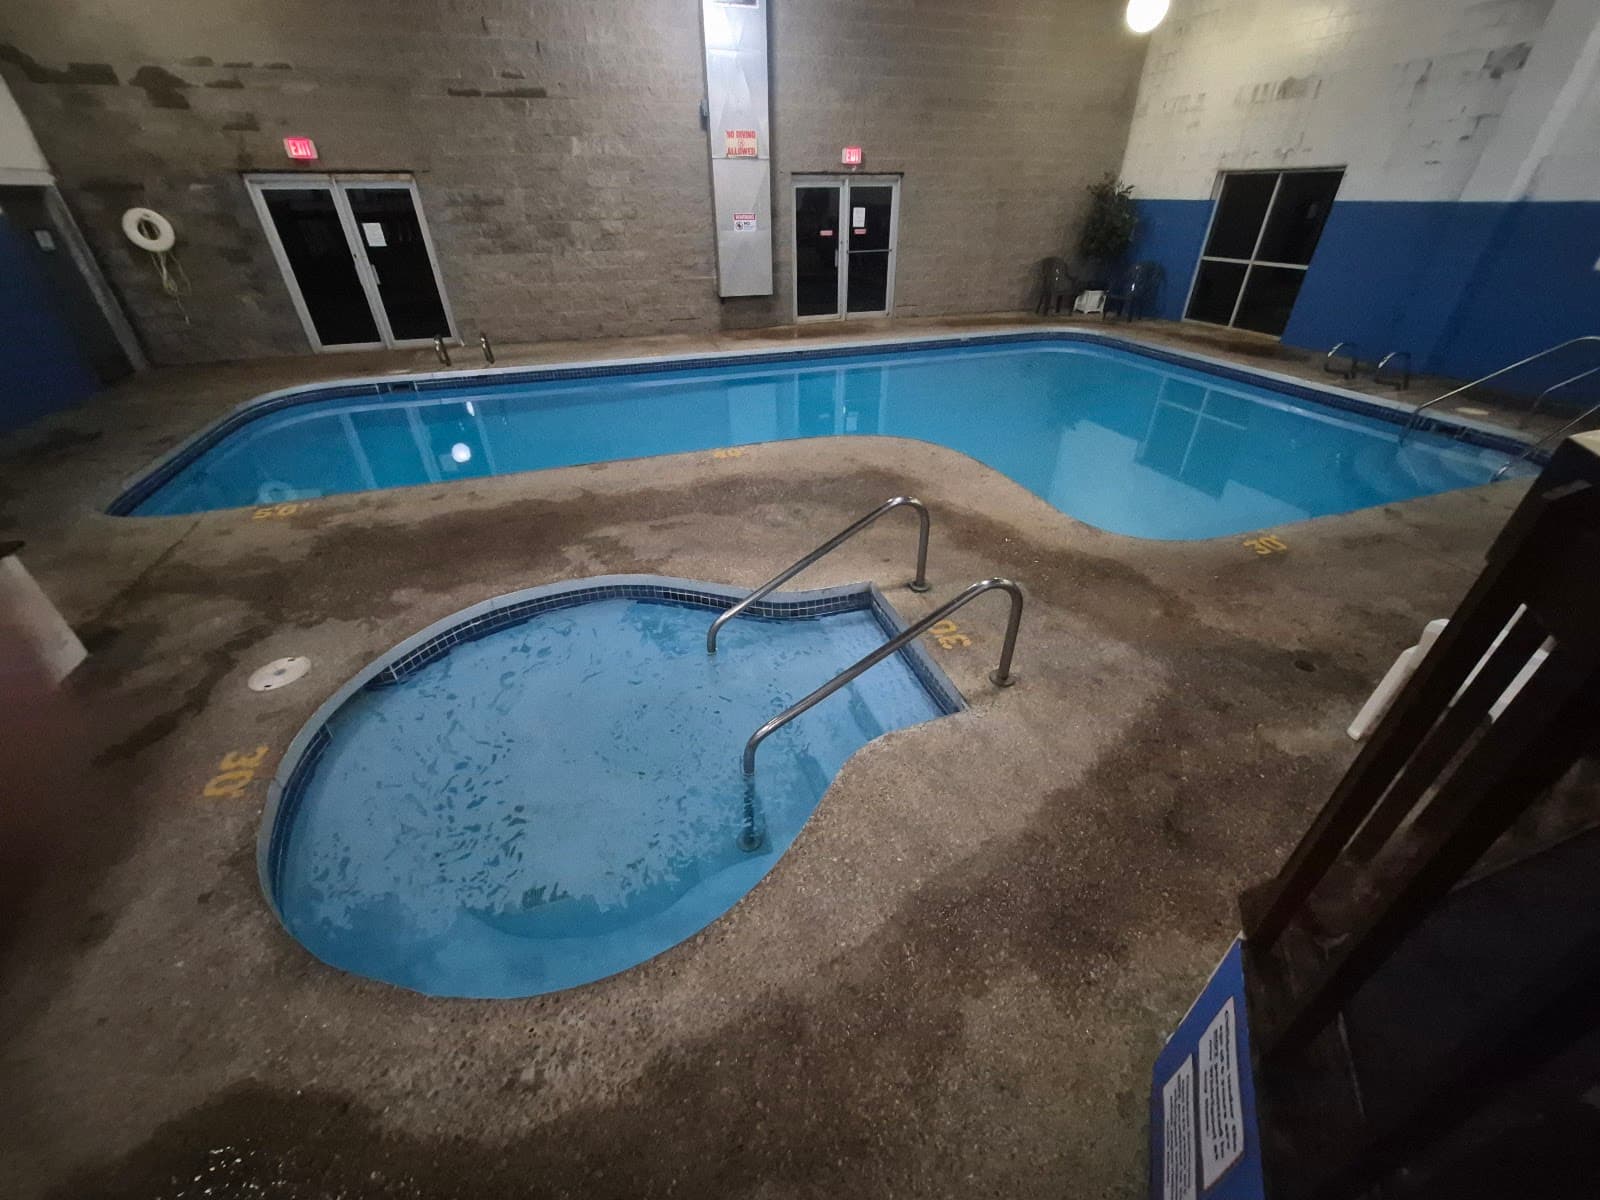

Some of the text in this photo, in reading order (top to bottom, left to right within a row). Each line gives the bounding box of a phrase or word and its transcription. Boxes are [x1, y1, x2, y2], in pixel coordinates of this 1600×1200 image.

[736, 130, 756, 139] DIVING
[288, 139, 312, 156] EXIT
[727, 147, 756, 156] ALLOWED
